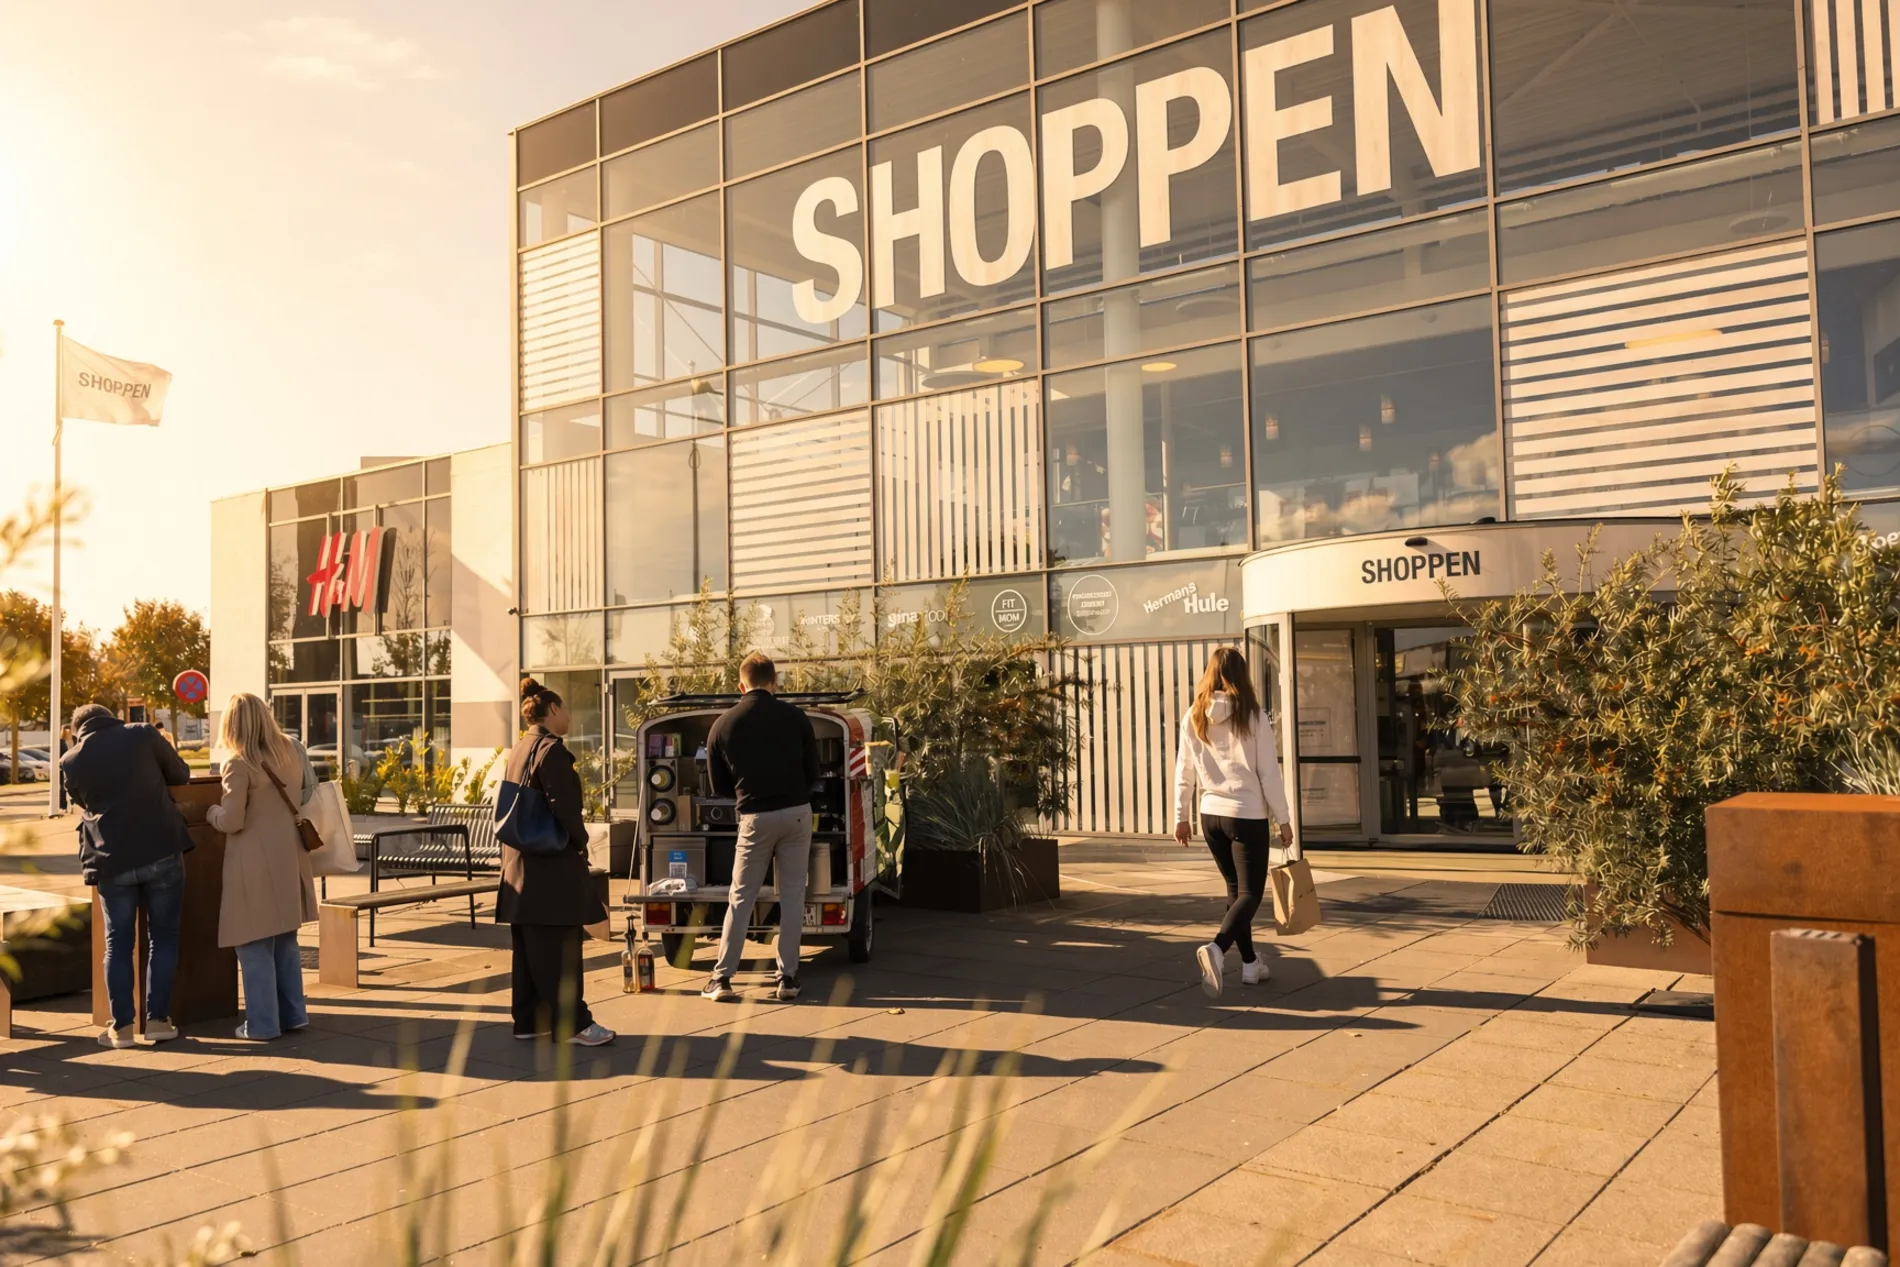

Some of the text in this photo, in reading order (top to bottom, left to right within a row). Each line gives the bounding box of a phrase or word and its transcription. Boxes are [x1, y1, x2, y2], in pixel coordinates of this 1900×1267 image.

[791, 0, 1482, 324] SHOPPEN
[78, 371, 152, 399] SHOPPEN
[306, 526, 382, 619] H&M
[1361, 550, 1481, 584] SHOPPEN
[1002, 598, 1016, 609] FIT
[1143, 581, 1197, 614] Hermans
[1183, 592, 1230, 614] Hule
[998, 612, 1020, 624] MOM
